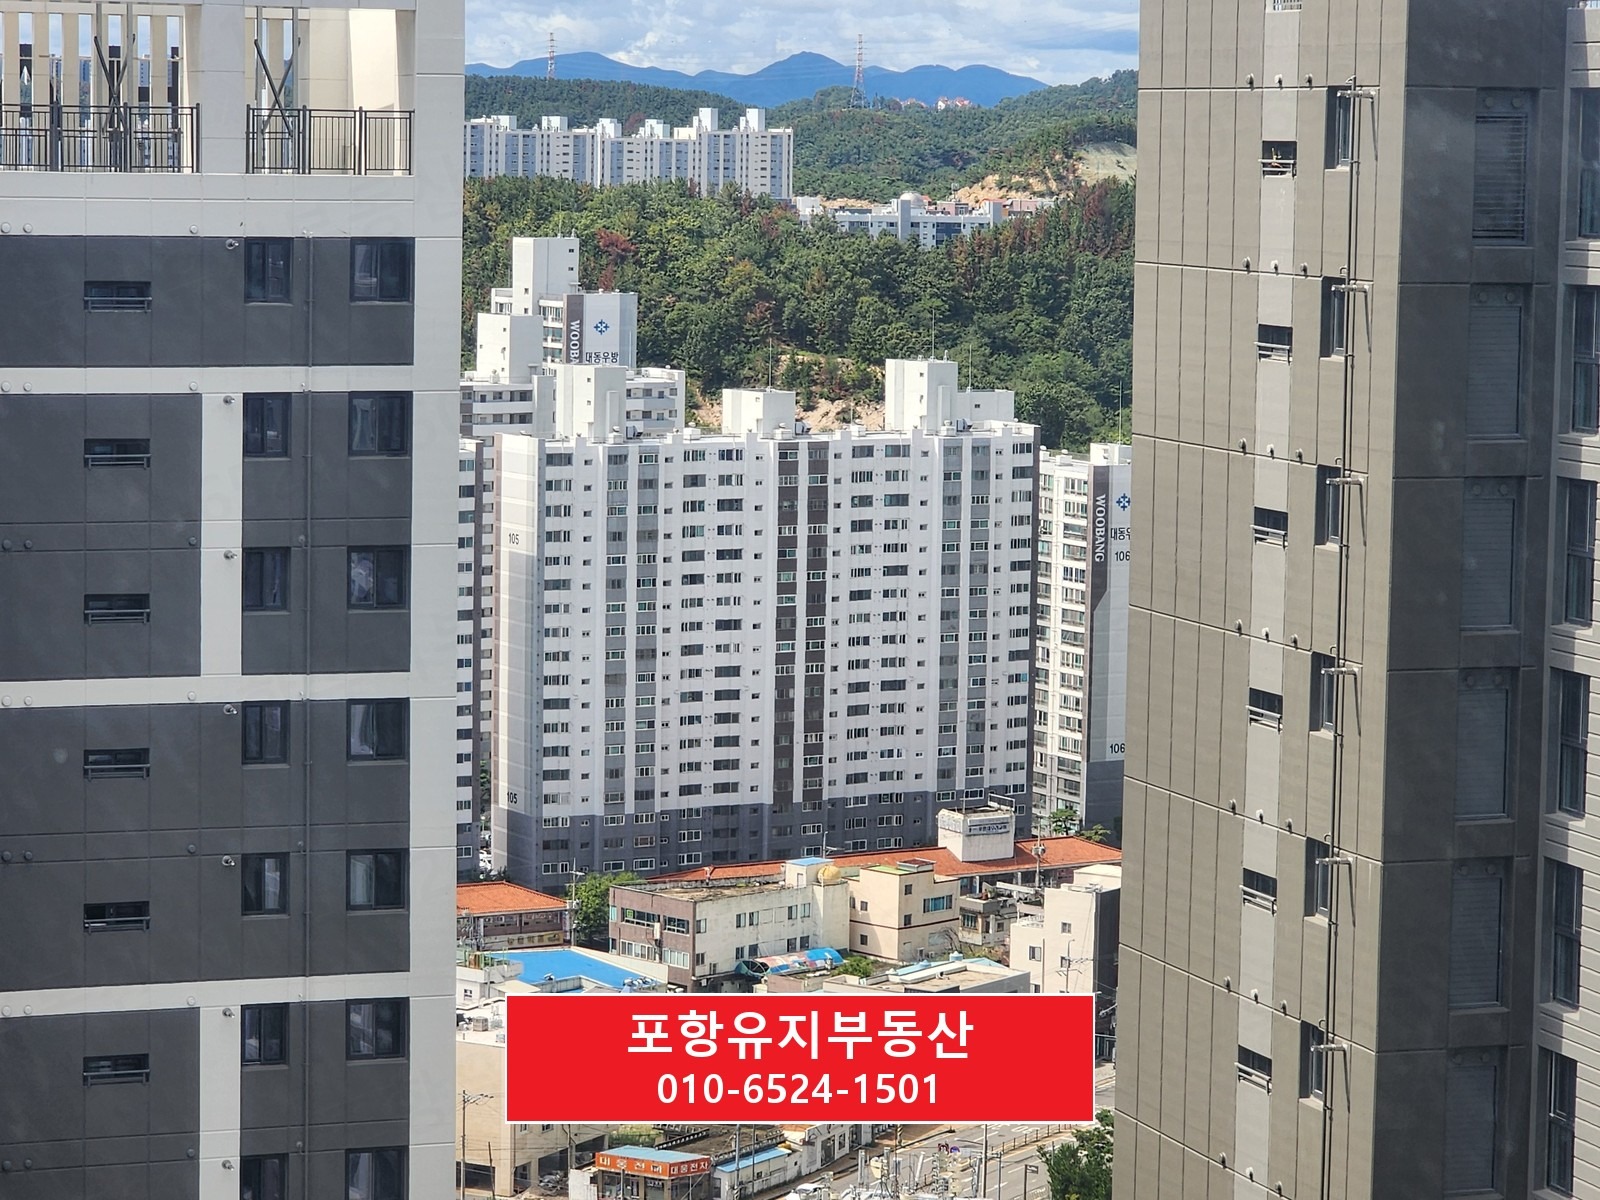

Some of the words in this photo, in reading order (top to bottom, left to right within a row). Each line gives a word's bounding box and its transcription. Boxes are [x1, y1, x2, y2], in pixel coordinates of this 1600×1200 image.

[585, 351, 618, 363] 대동우방
[1095, 494, 1106, 562] WOOBANG
[508, 532, 520, 545] 105
[1115, 550, 1131, 562] 106
[1109, 742, 1126, 754] 106
[507, 791, 518, 804] 105
